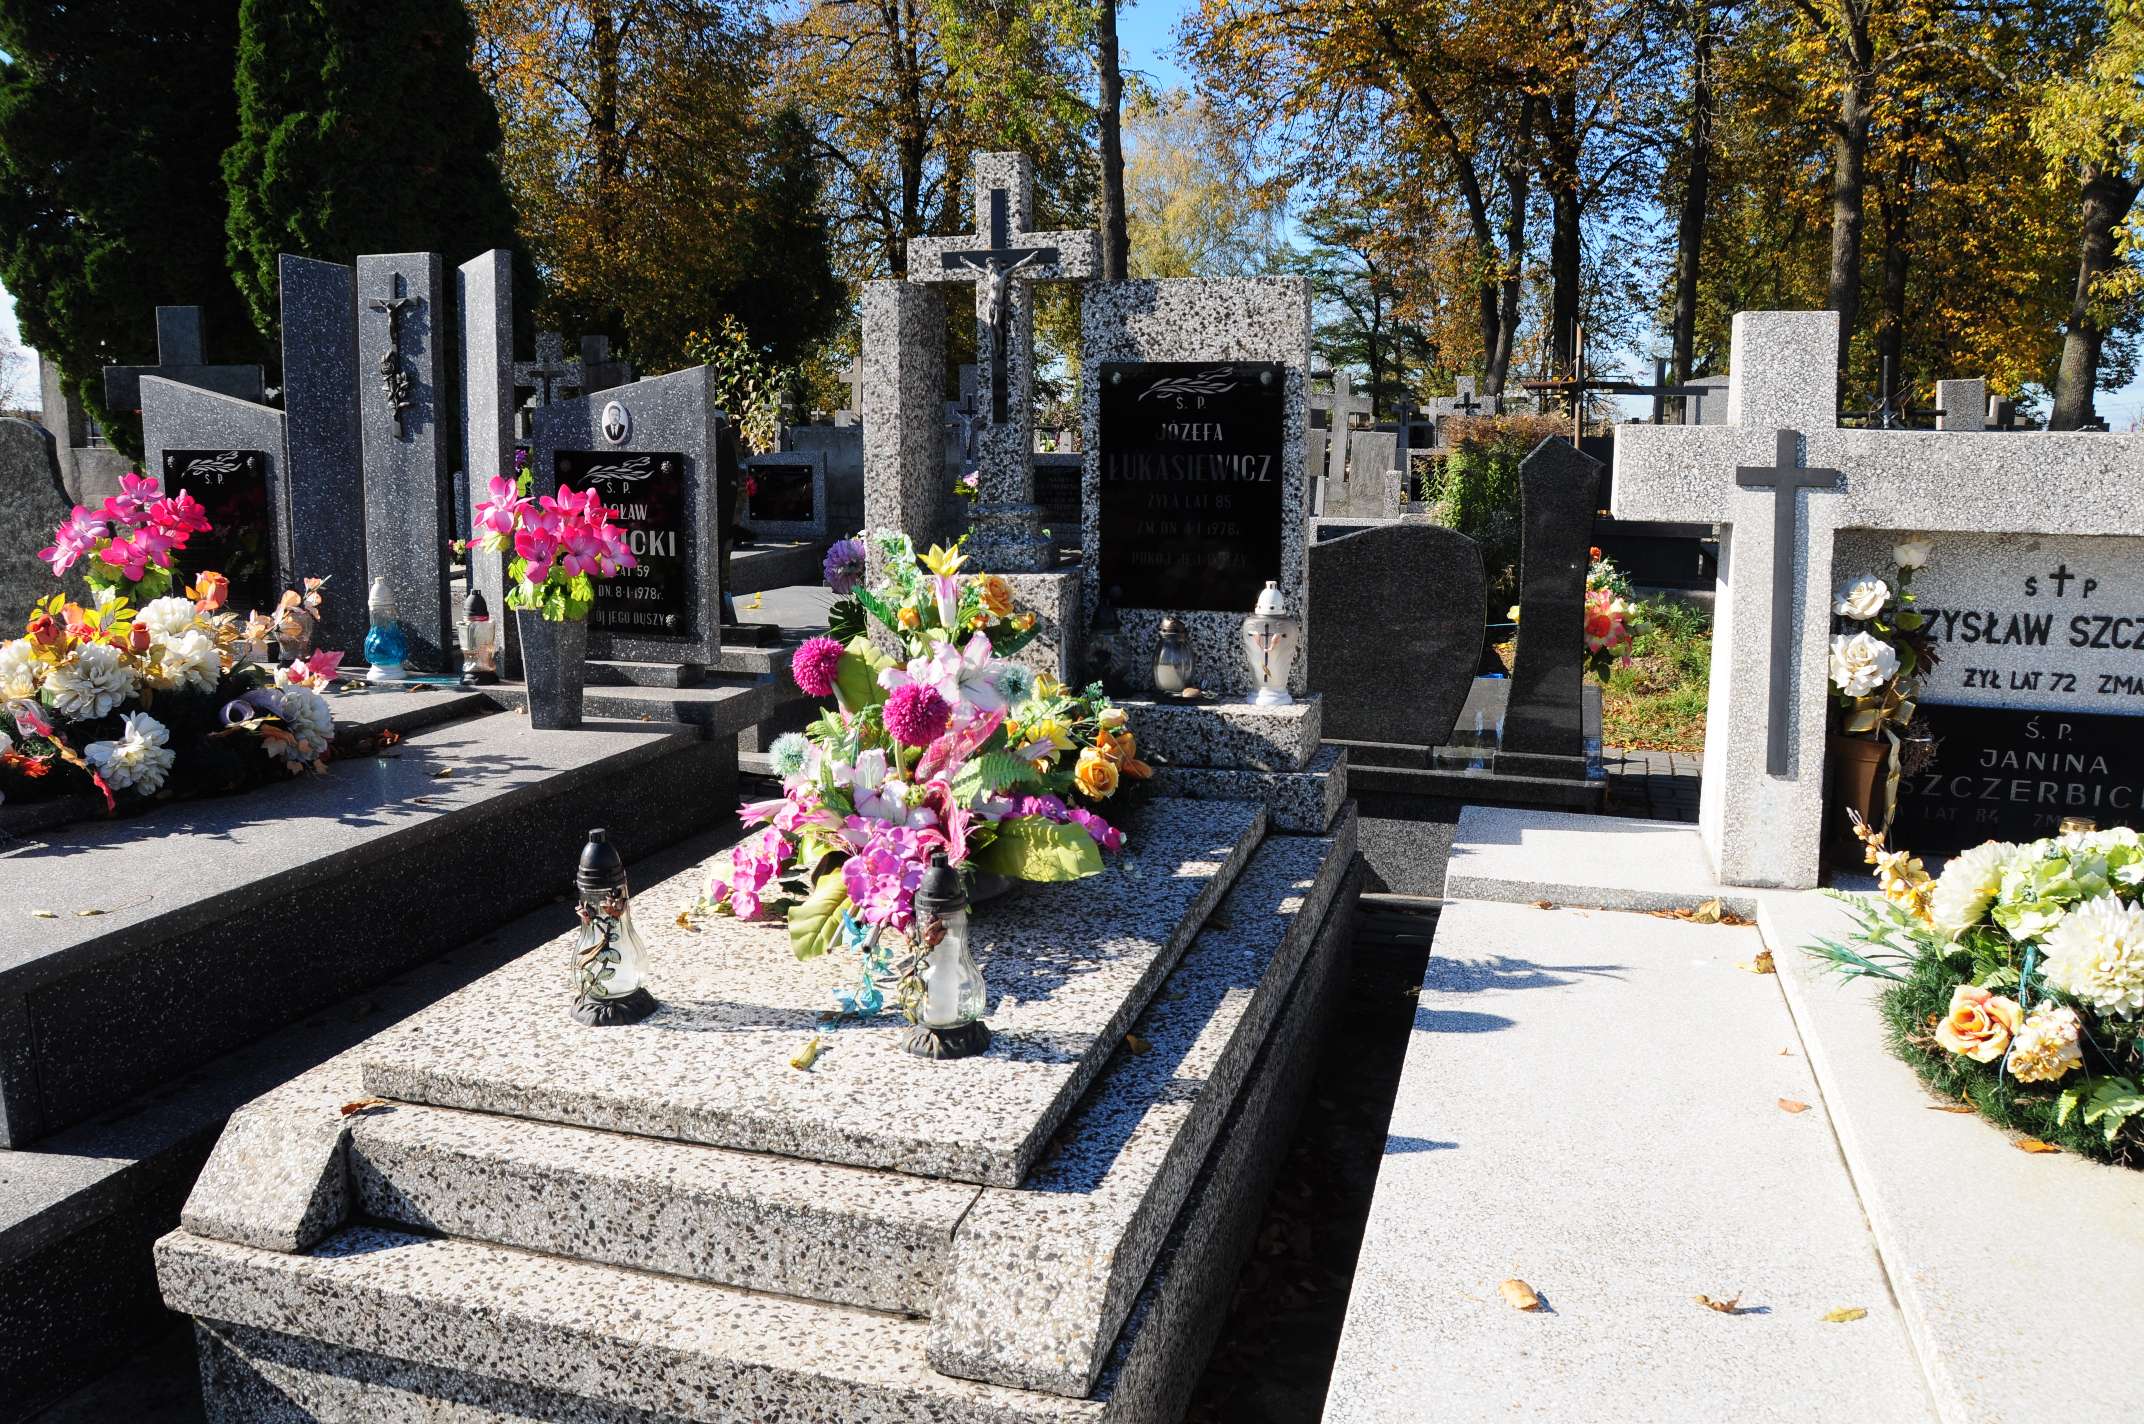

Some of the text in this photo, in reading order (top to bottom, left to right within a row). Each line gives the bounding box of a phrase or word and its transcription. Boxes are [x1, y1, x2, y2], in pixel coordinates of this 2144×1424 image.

[1197, 396, 1207, 409] P.
[1154, 420, 1223, 441] JÓZEFA
[1107, 452, 1273, 482] ŁUKASIEWICZ
[218, 473, 225, 485] P.
[623, 481, 631, 494] P.
[636, 564, 650, 577] 59
[2083, 578, 2097, 598] P
[607, 610, 630, 624] JEGO
[2010, 671, 2042, 691] LAT
[2050, 673, 2077, 693] 72
[2024, 715, 2073, 741] Ś. P.
[1979, 748, 2108, 775] JANINA
[1902, 774, 2144, 811] SZCZERBIC
